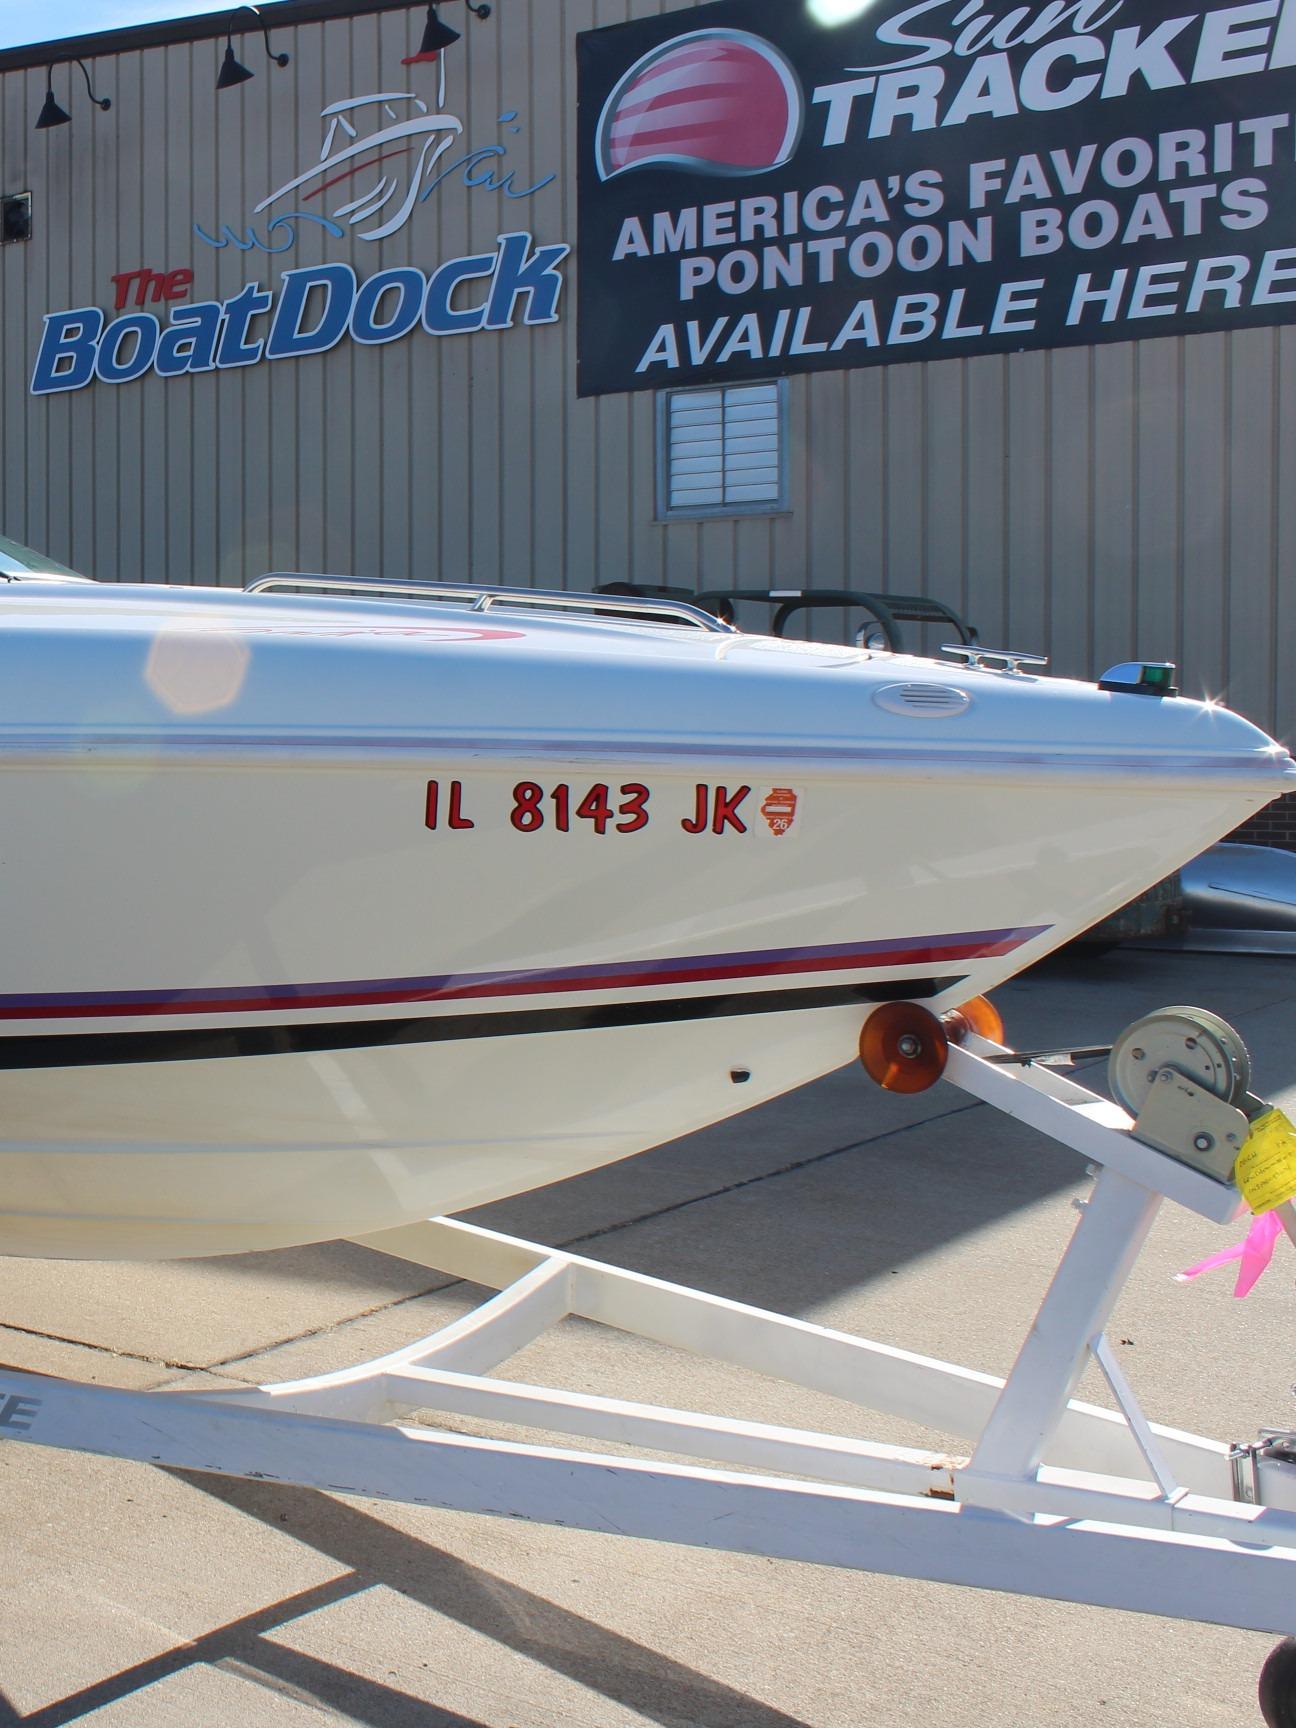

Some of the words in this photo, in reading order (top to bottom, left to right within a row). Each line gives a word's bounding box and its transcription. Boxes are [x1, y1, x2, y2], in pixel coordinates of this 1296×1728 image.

[812, 0, 1296, 148] TRACKE
[843, 0, 1124, 72] Sun
[612, 168, 944, 261] AMERICA'S
[969, 112, 1296, 210] FAVORIT
[680, 216, 992, 300] PONTOON
[1019, 177, 1269, 257] BOATS
[110, 267, 194, 309] The
[635, 278, 1045, 373] AVAILABLE
[1065, 247, 1296, 327] HERE
[424, 779, 475, 831] IL
[510, 780, 651, 836] 8143
[680, 783, 752, 836] JK
